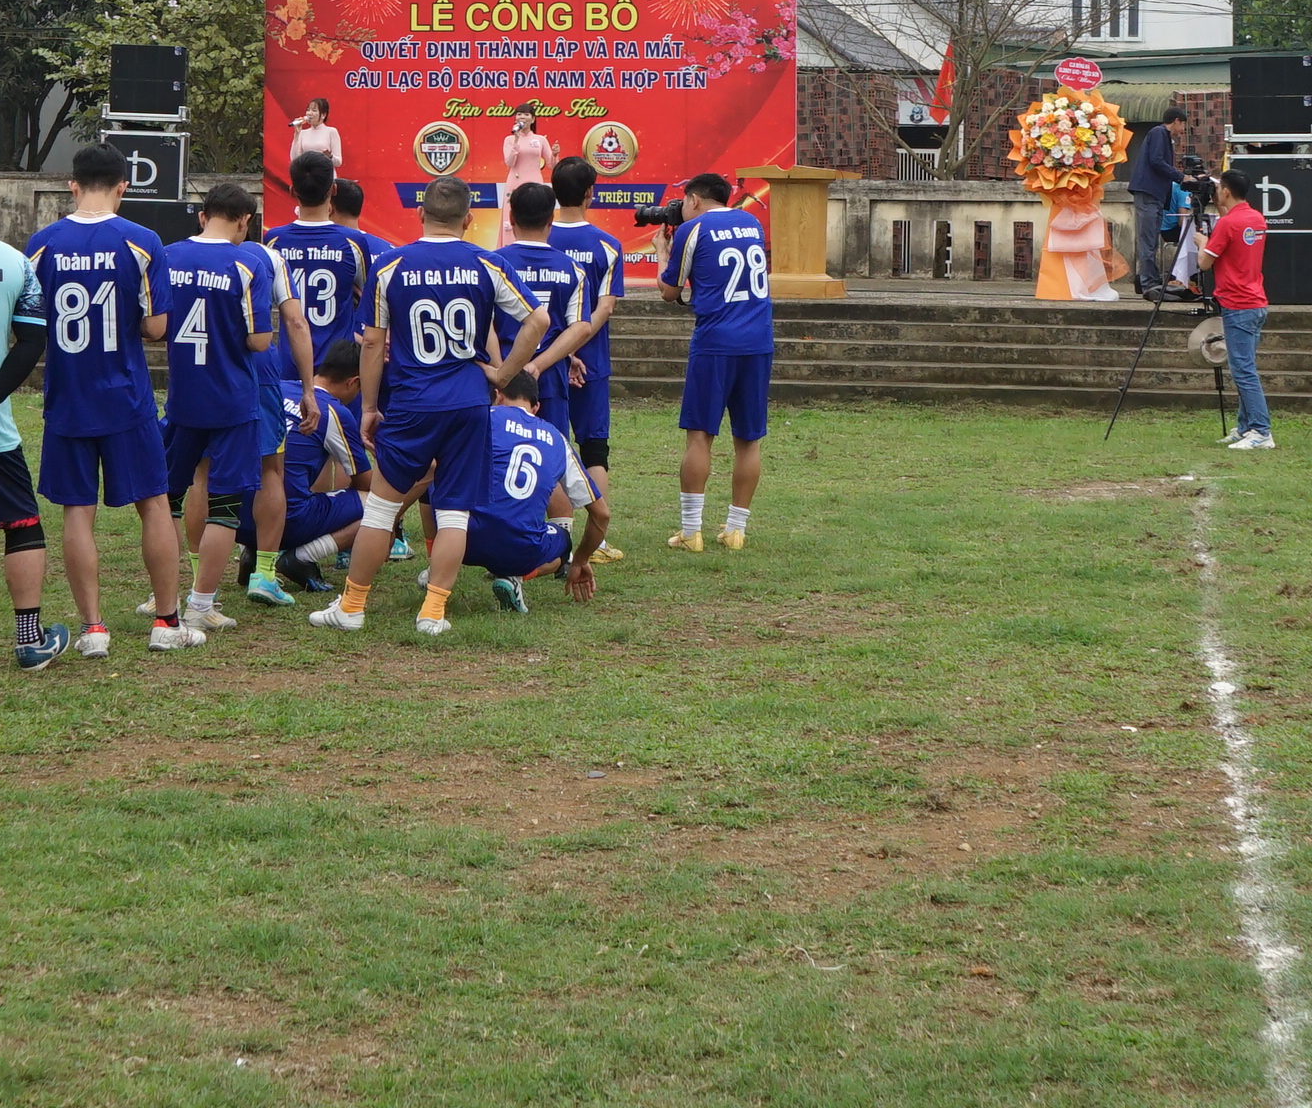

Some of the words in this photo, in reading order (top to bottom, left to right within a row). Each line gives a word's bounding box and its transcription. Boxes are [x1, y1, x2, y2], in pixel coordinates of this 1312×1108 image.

[361, 35, 421, 62] QUYẾT
[425, 41, 470, 63] ĐỊNH
[476, 36, 537, 59] THÀNH
[543, 36, 579, 63] LẬP
[583, 36, 609, 59] VÀ
[613, 40, 639, 59] RA
[644, 33, 684, 59] MẮT
[345, 66, 382, 89] CÂU
[387, 71, 423, 92] LẠC
[427, 67, 453, 92] BỘ
[458, 66, 508, 89] BÓNG
[513, 66, 539, 89] ĐÁ
[544, 70, 586, 89] NAM
[590, 66, 615, 89] XÃ
[620, 69, 659, 92] HỢP
[663, 64, 707, 90] TIẾN
[442, 97, 483, 120] Trận
[486, 99, 515, 117] cầu
[564, 97, 609, 119] Hữu
[598, 191, 630, 205] TRIỆU
[633, 191, 655, 203] SƠN
[710, 229, 732, 242] Lee
[733, 227, 760, 239] Bang
[54, 253, 90, 271] Toàn
[94, 252, 116, 270] PK
[281, 247, 303, 261] Đức
[307, 245, 342, 262] Thắng
[625, 252, 643, 264] HỢP
[169, 268, 193, 287] gọc
[197, 270, 231, 291] Thịnh
[402, 271, 421, 286] Tài
[424, 270, 442, 285] GA
[445, 267, 479, 285] LĂNG
[515, 266, 537, 283] uyễn
[539, 268, 570, 284] Khuyên
[718, 244, 768, 303] 28
[292, 268, 337, 326] 13
[55, 281, 117, 354] 81
[174, 297, 208, 365] 4
[409, 298, 476, 365] 69
[505, 419, 532, 439] Hân
[536, 429, 553, 446] Hà
[504, 444, 542, 500] 6
